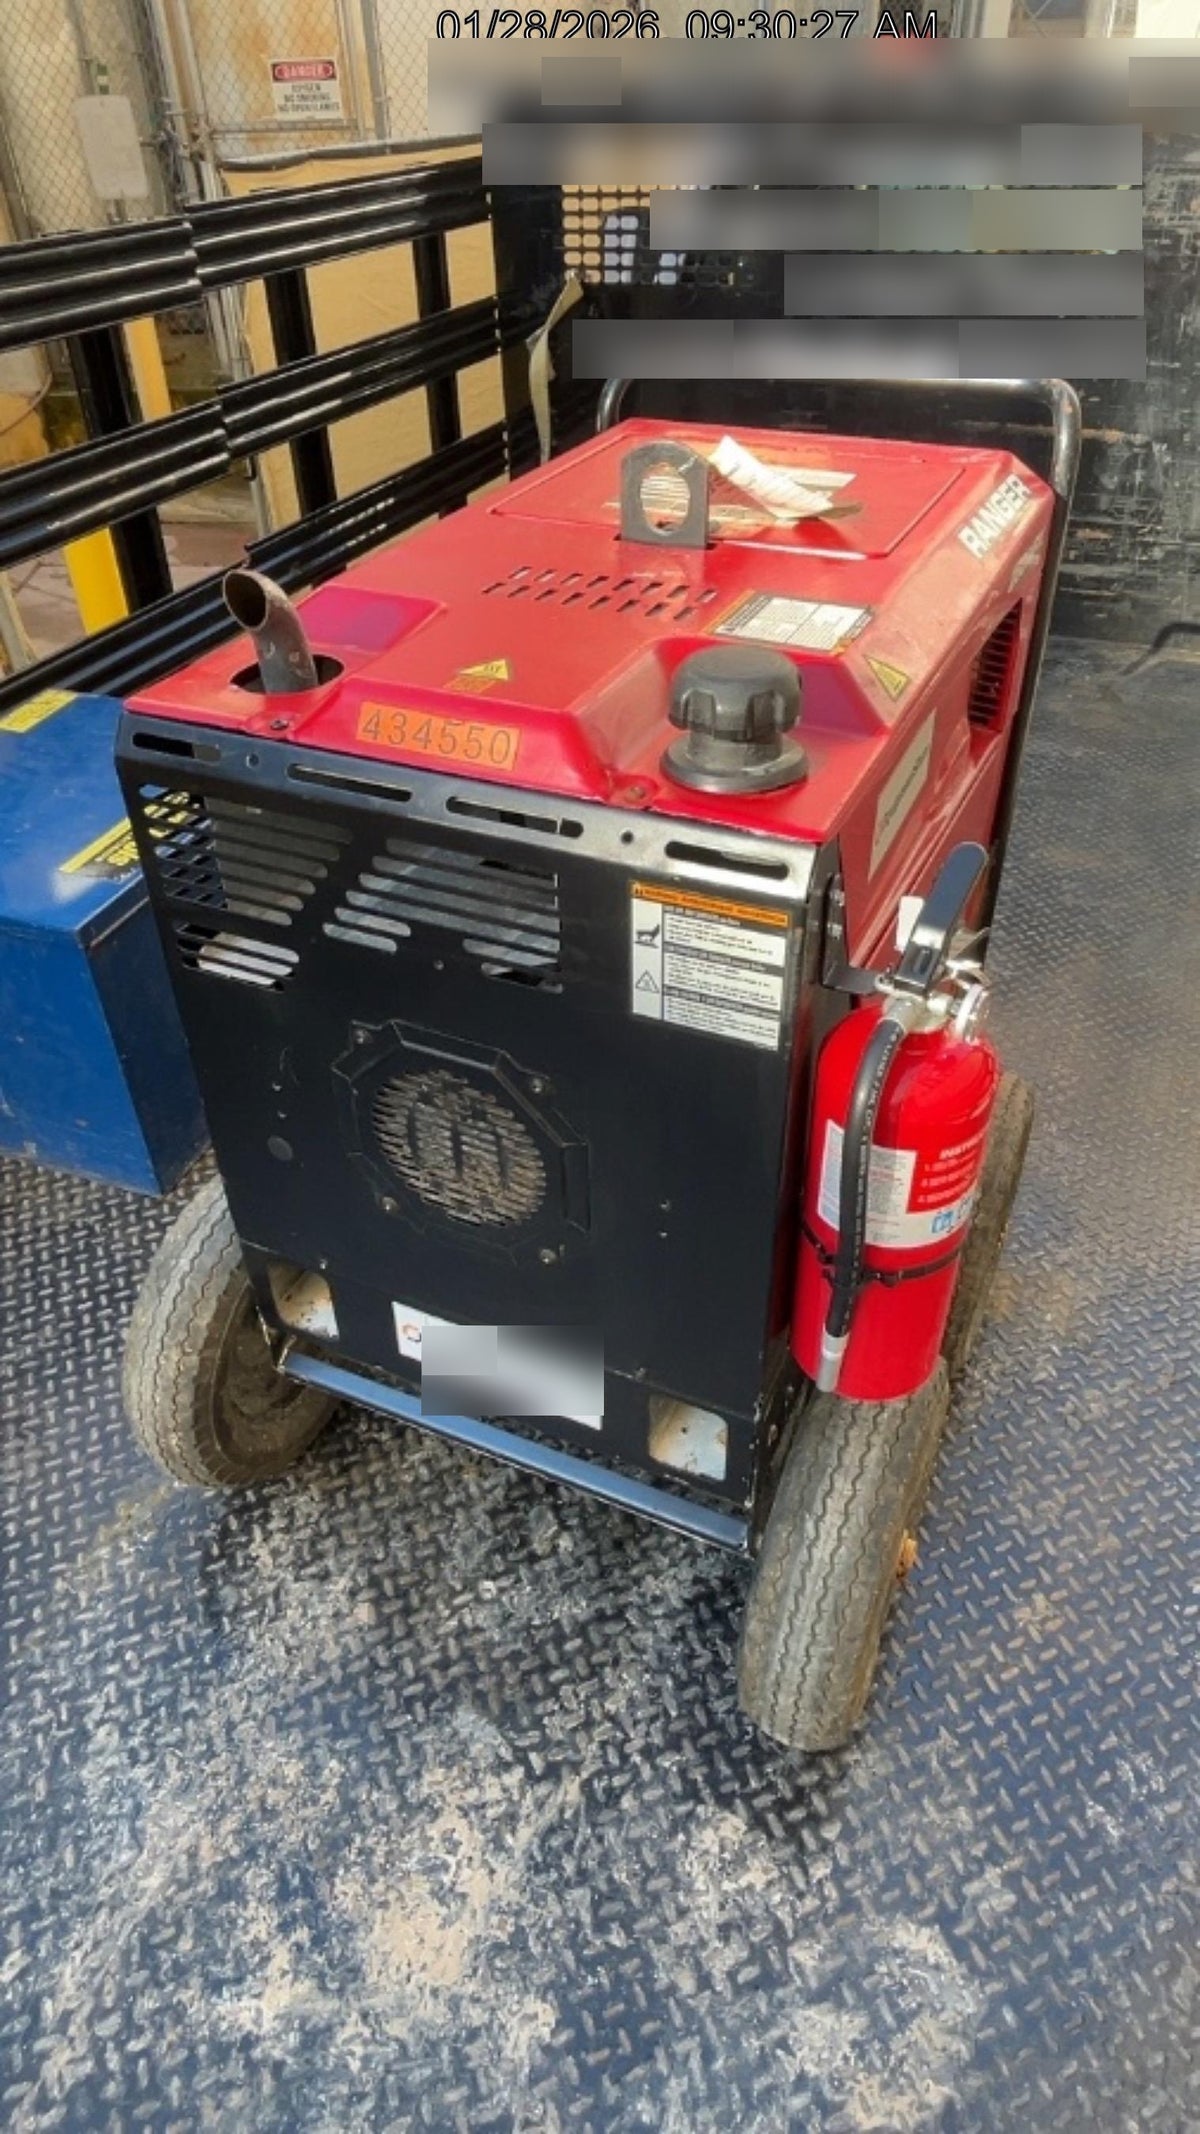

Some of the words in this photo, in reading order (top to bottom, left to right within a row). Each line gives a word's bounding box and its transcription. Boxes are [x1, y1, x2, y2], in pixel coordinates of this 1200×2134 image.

[282, 63, 324, 79] DANGER
[957, 473, 1032, 558] RANGER
[362, 709, 511, 765] 434550
